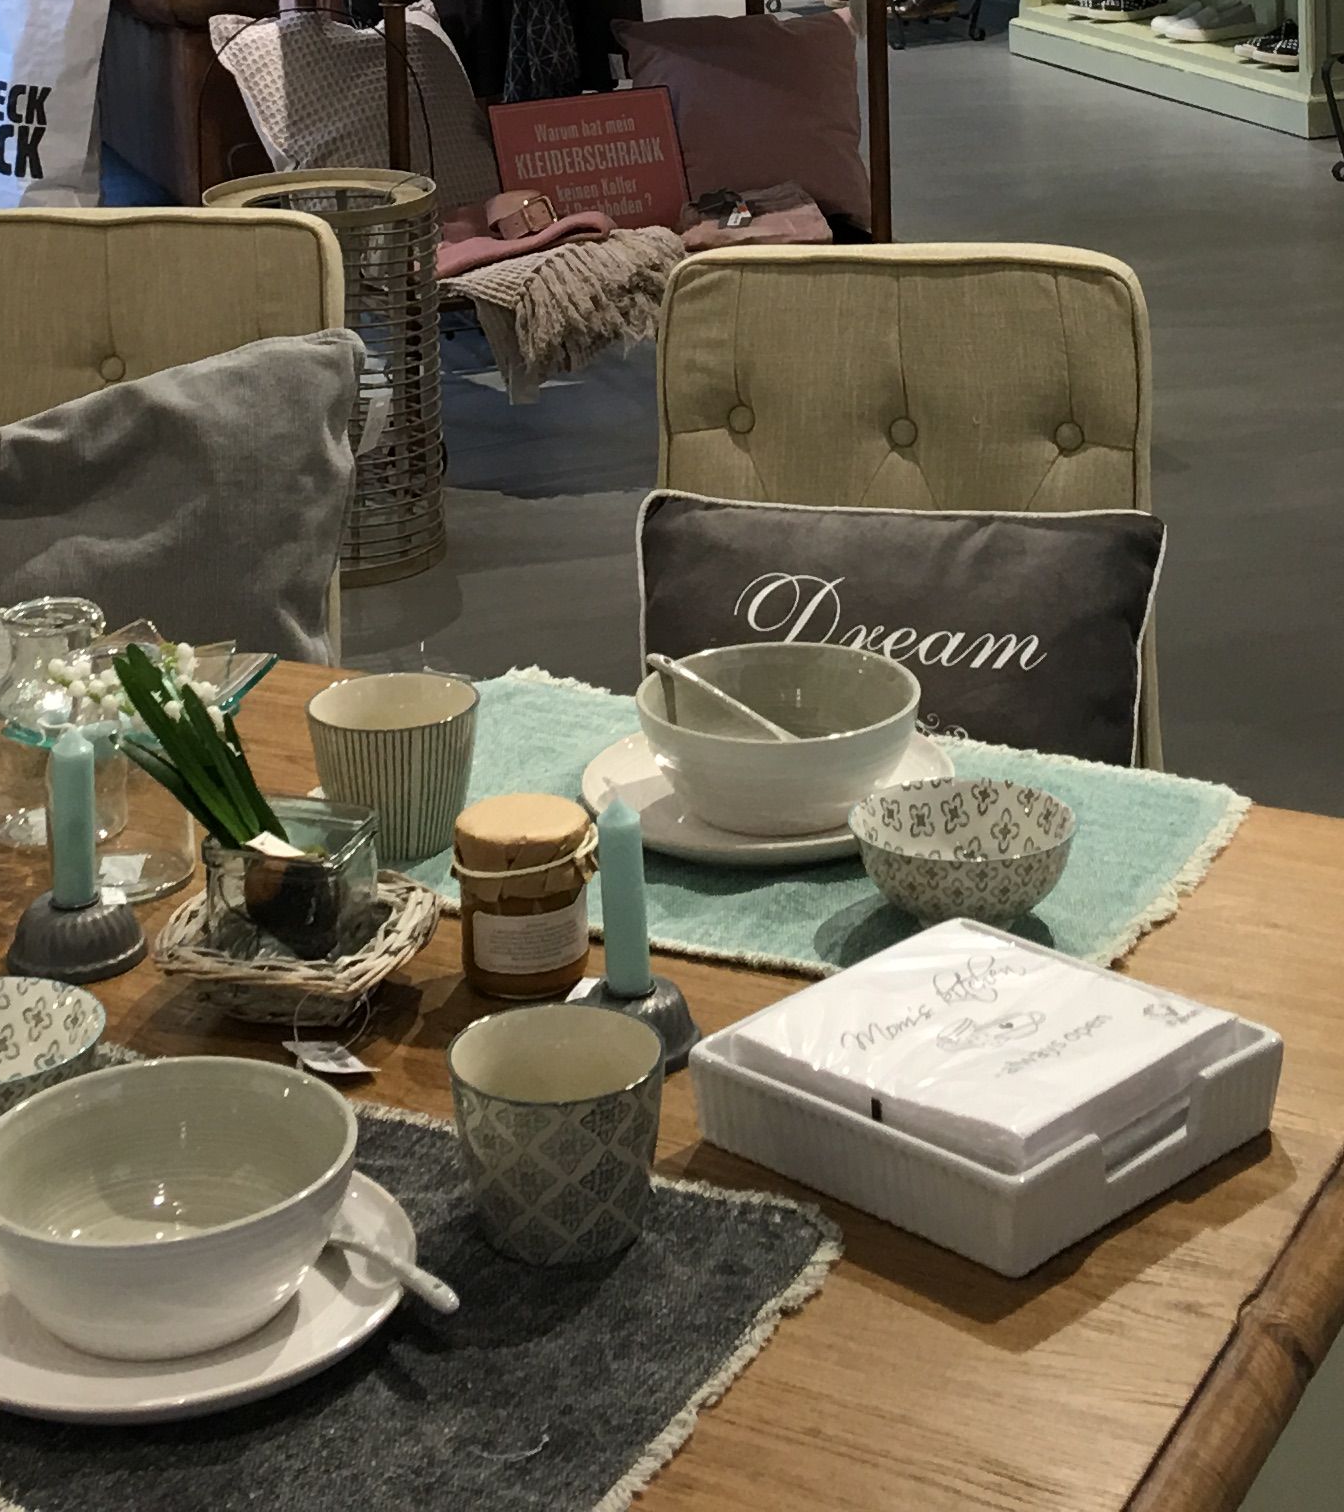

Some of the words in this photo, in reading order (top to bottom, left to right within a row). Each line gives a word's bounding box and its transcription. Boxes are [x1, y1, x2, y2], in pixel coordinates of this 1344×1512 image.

[534, 122, 580, 143] Warum
[581, 119, 604, 137] hat
[606, 114, 635, 133] mein
[515, 137, 665, 180] KLEIDERSCHRANK
[574, 196, 643, 216] Dhboden
[734, 572, 1047, 671] Dream
